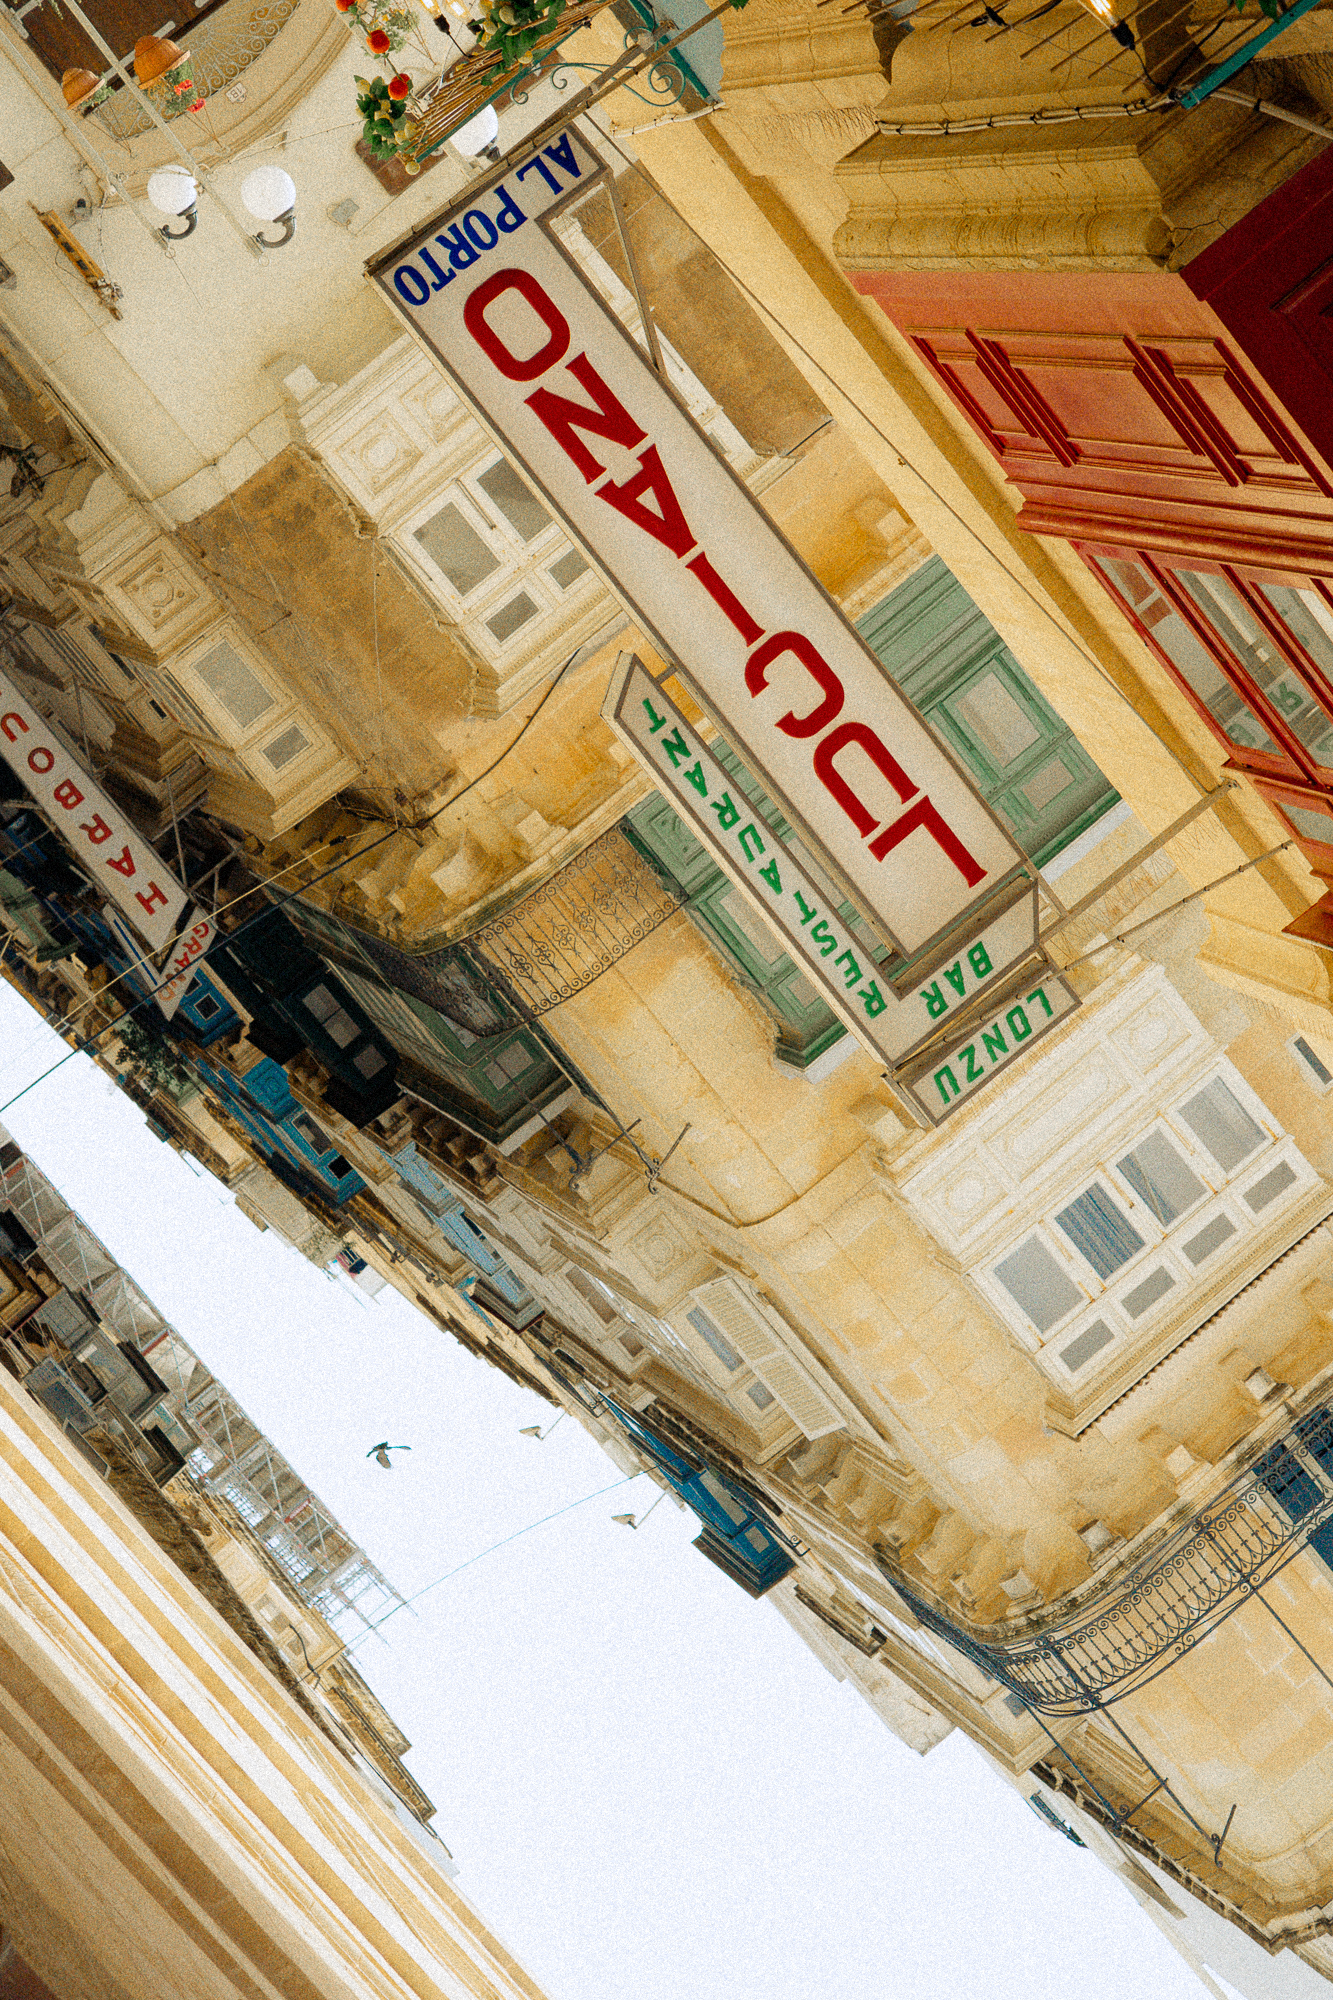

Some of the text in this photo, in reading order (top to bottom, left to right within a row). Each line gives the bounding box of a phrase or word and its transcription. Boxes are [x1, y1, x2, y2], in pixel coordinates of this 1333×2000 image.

[393, 132, 582, 306] AL PORTO
[463, 267, 988, 888] LUCIANO
[0, 694, 169, 915] HARBOU
[642, 697, 888, 1019] RESTAURANT
[158, 921, 209, 1001] GRAND
[919, 940, 993, 1020] BAR
[932, 987, 1055, 1104] LONZU
